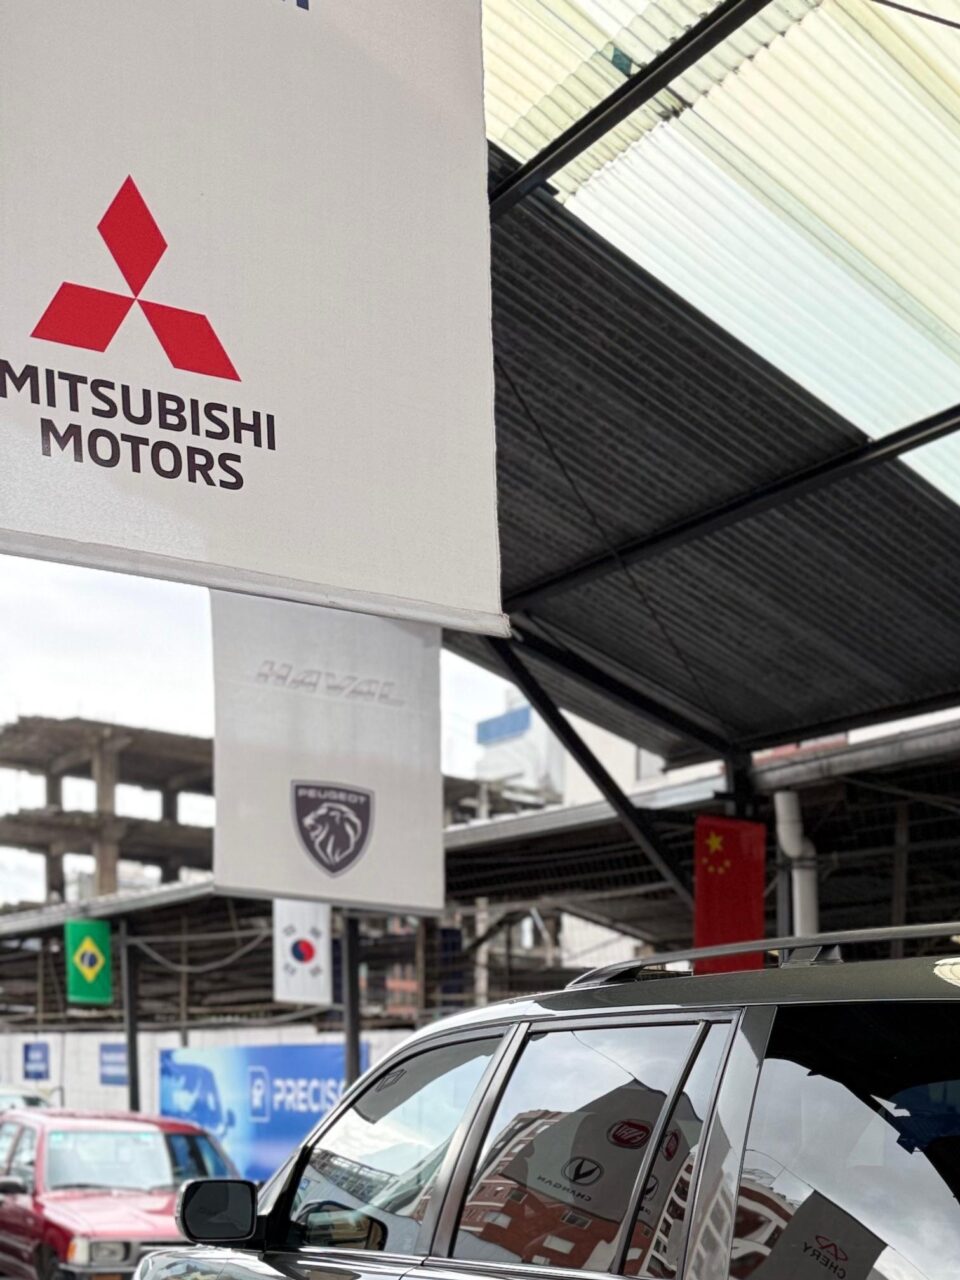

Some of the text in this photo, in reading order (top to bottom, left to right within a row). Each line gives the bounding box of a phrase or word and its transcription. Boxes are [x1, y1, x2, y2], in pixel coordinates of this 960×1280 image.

[0, 359, 276, 450] MITSUBISHI
[40, 418, 244, 490] MOTORS
[255, 659, 404, 706] HAVAL
[297, 787, 366, 804] PEUGEOT
[273, 1077, 345, 1112] PRECIS
